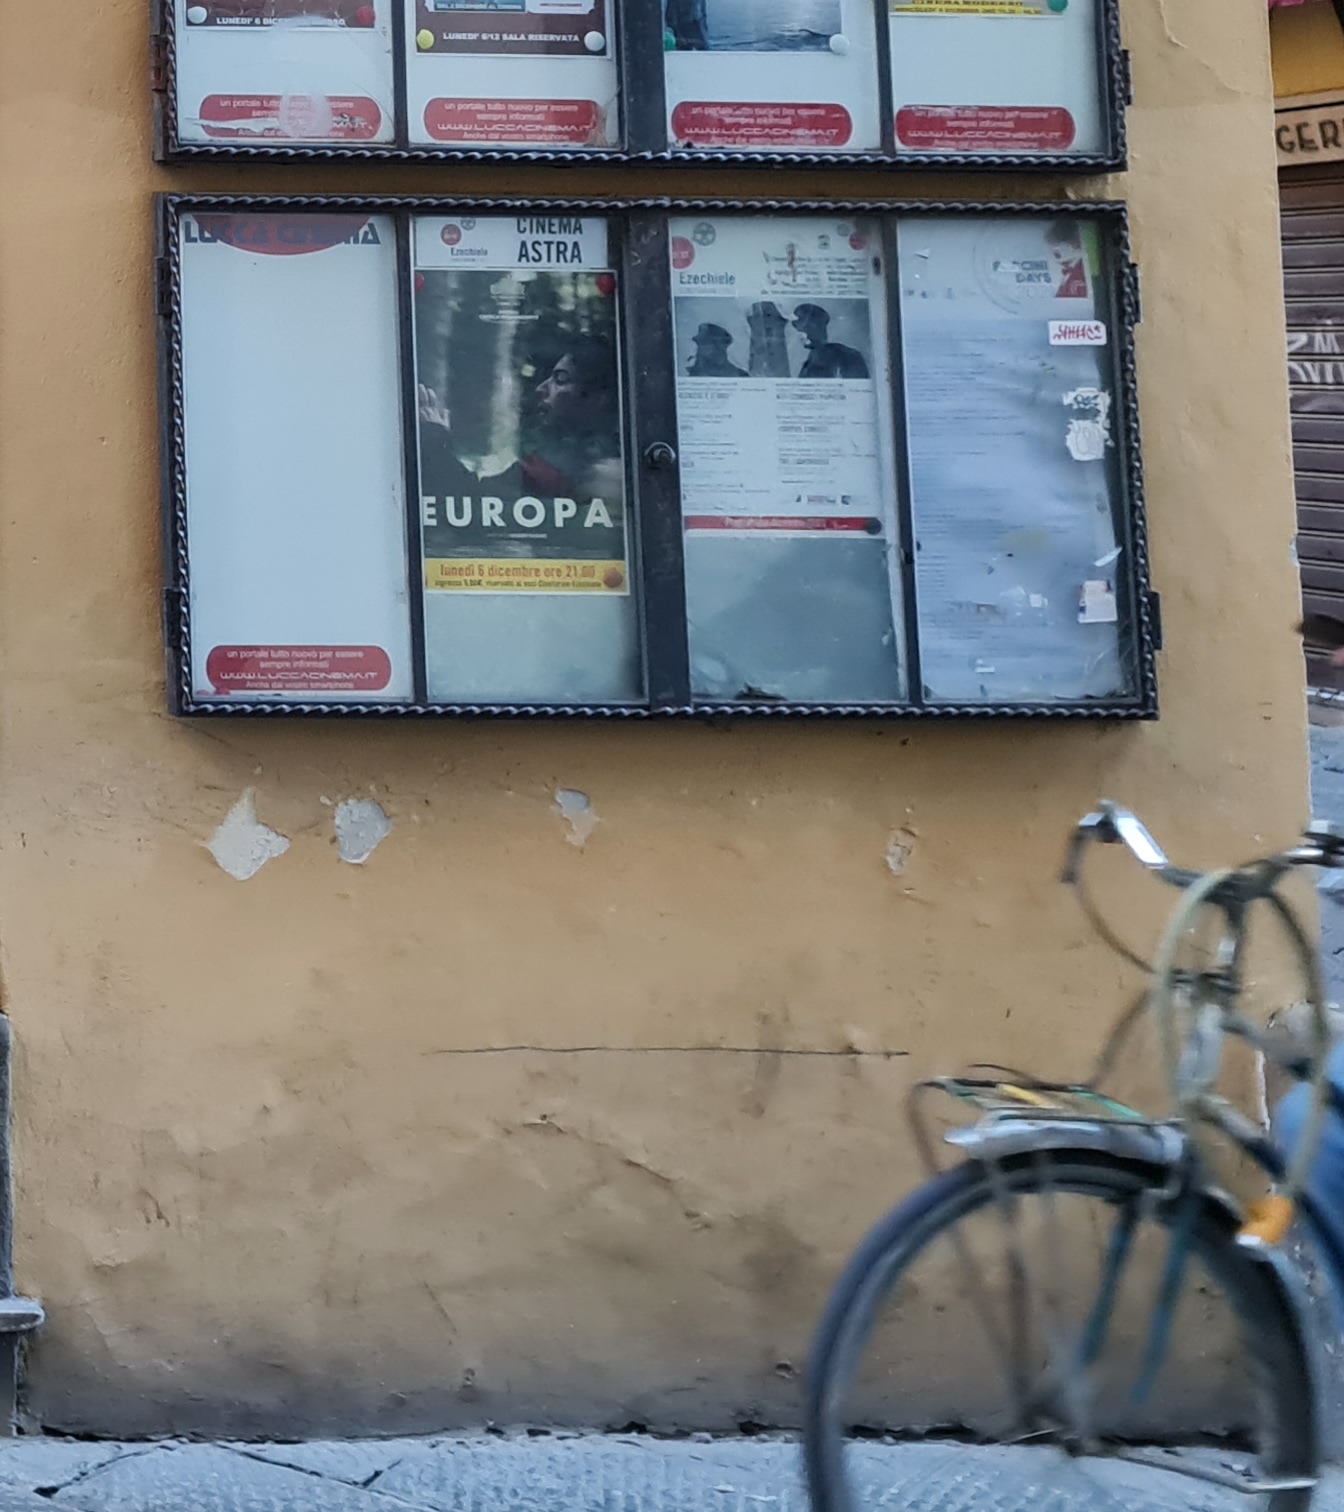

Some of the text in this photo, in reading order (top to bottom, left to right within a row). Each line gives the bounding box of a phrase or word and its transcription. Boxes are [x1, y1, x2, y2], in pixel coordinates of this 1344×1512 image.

[1276, 117, 1344, 154] GER
[516, 217, 583, 235] CINEMA
[517, 240, 583, 264] ASTRA
[679, 271, 736, 285] Ezechiele
[1016, 272, 1052, 284] DAYS
[422, 496, 614, 528] EUROPA
[478, 565, 485, 576] 6
[488, 565, 541, 578] dicembre
[543, 568, 562, 578] ore
